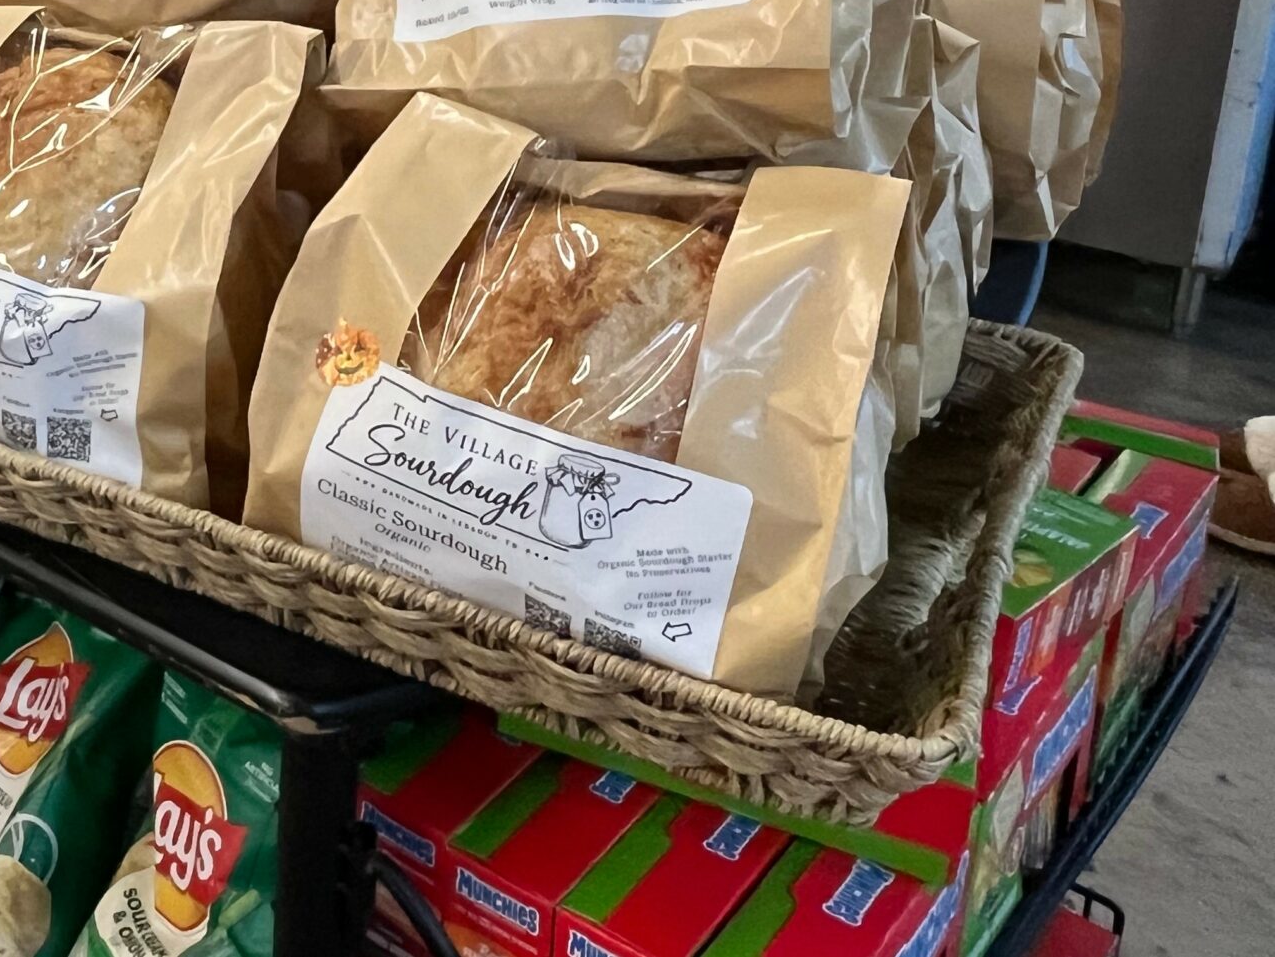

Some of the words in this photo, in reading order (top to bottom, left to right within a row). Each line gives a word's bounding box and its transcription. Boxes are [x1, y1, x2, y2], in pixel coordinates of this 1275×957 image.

[363, 423, 539, 526] Sourdough
[392, 402, 431, 436] THE
[445, 425, 539, 476] VILLAGE
[317, 478, 388, 520] Classic
[391, 510, 508, 576] Sourdough
[374, 523, 432, 554] Organic
[112, 909, 127, 924] &
[455, 866, 540, 937] MUNCHIES
